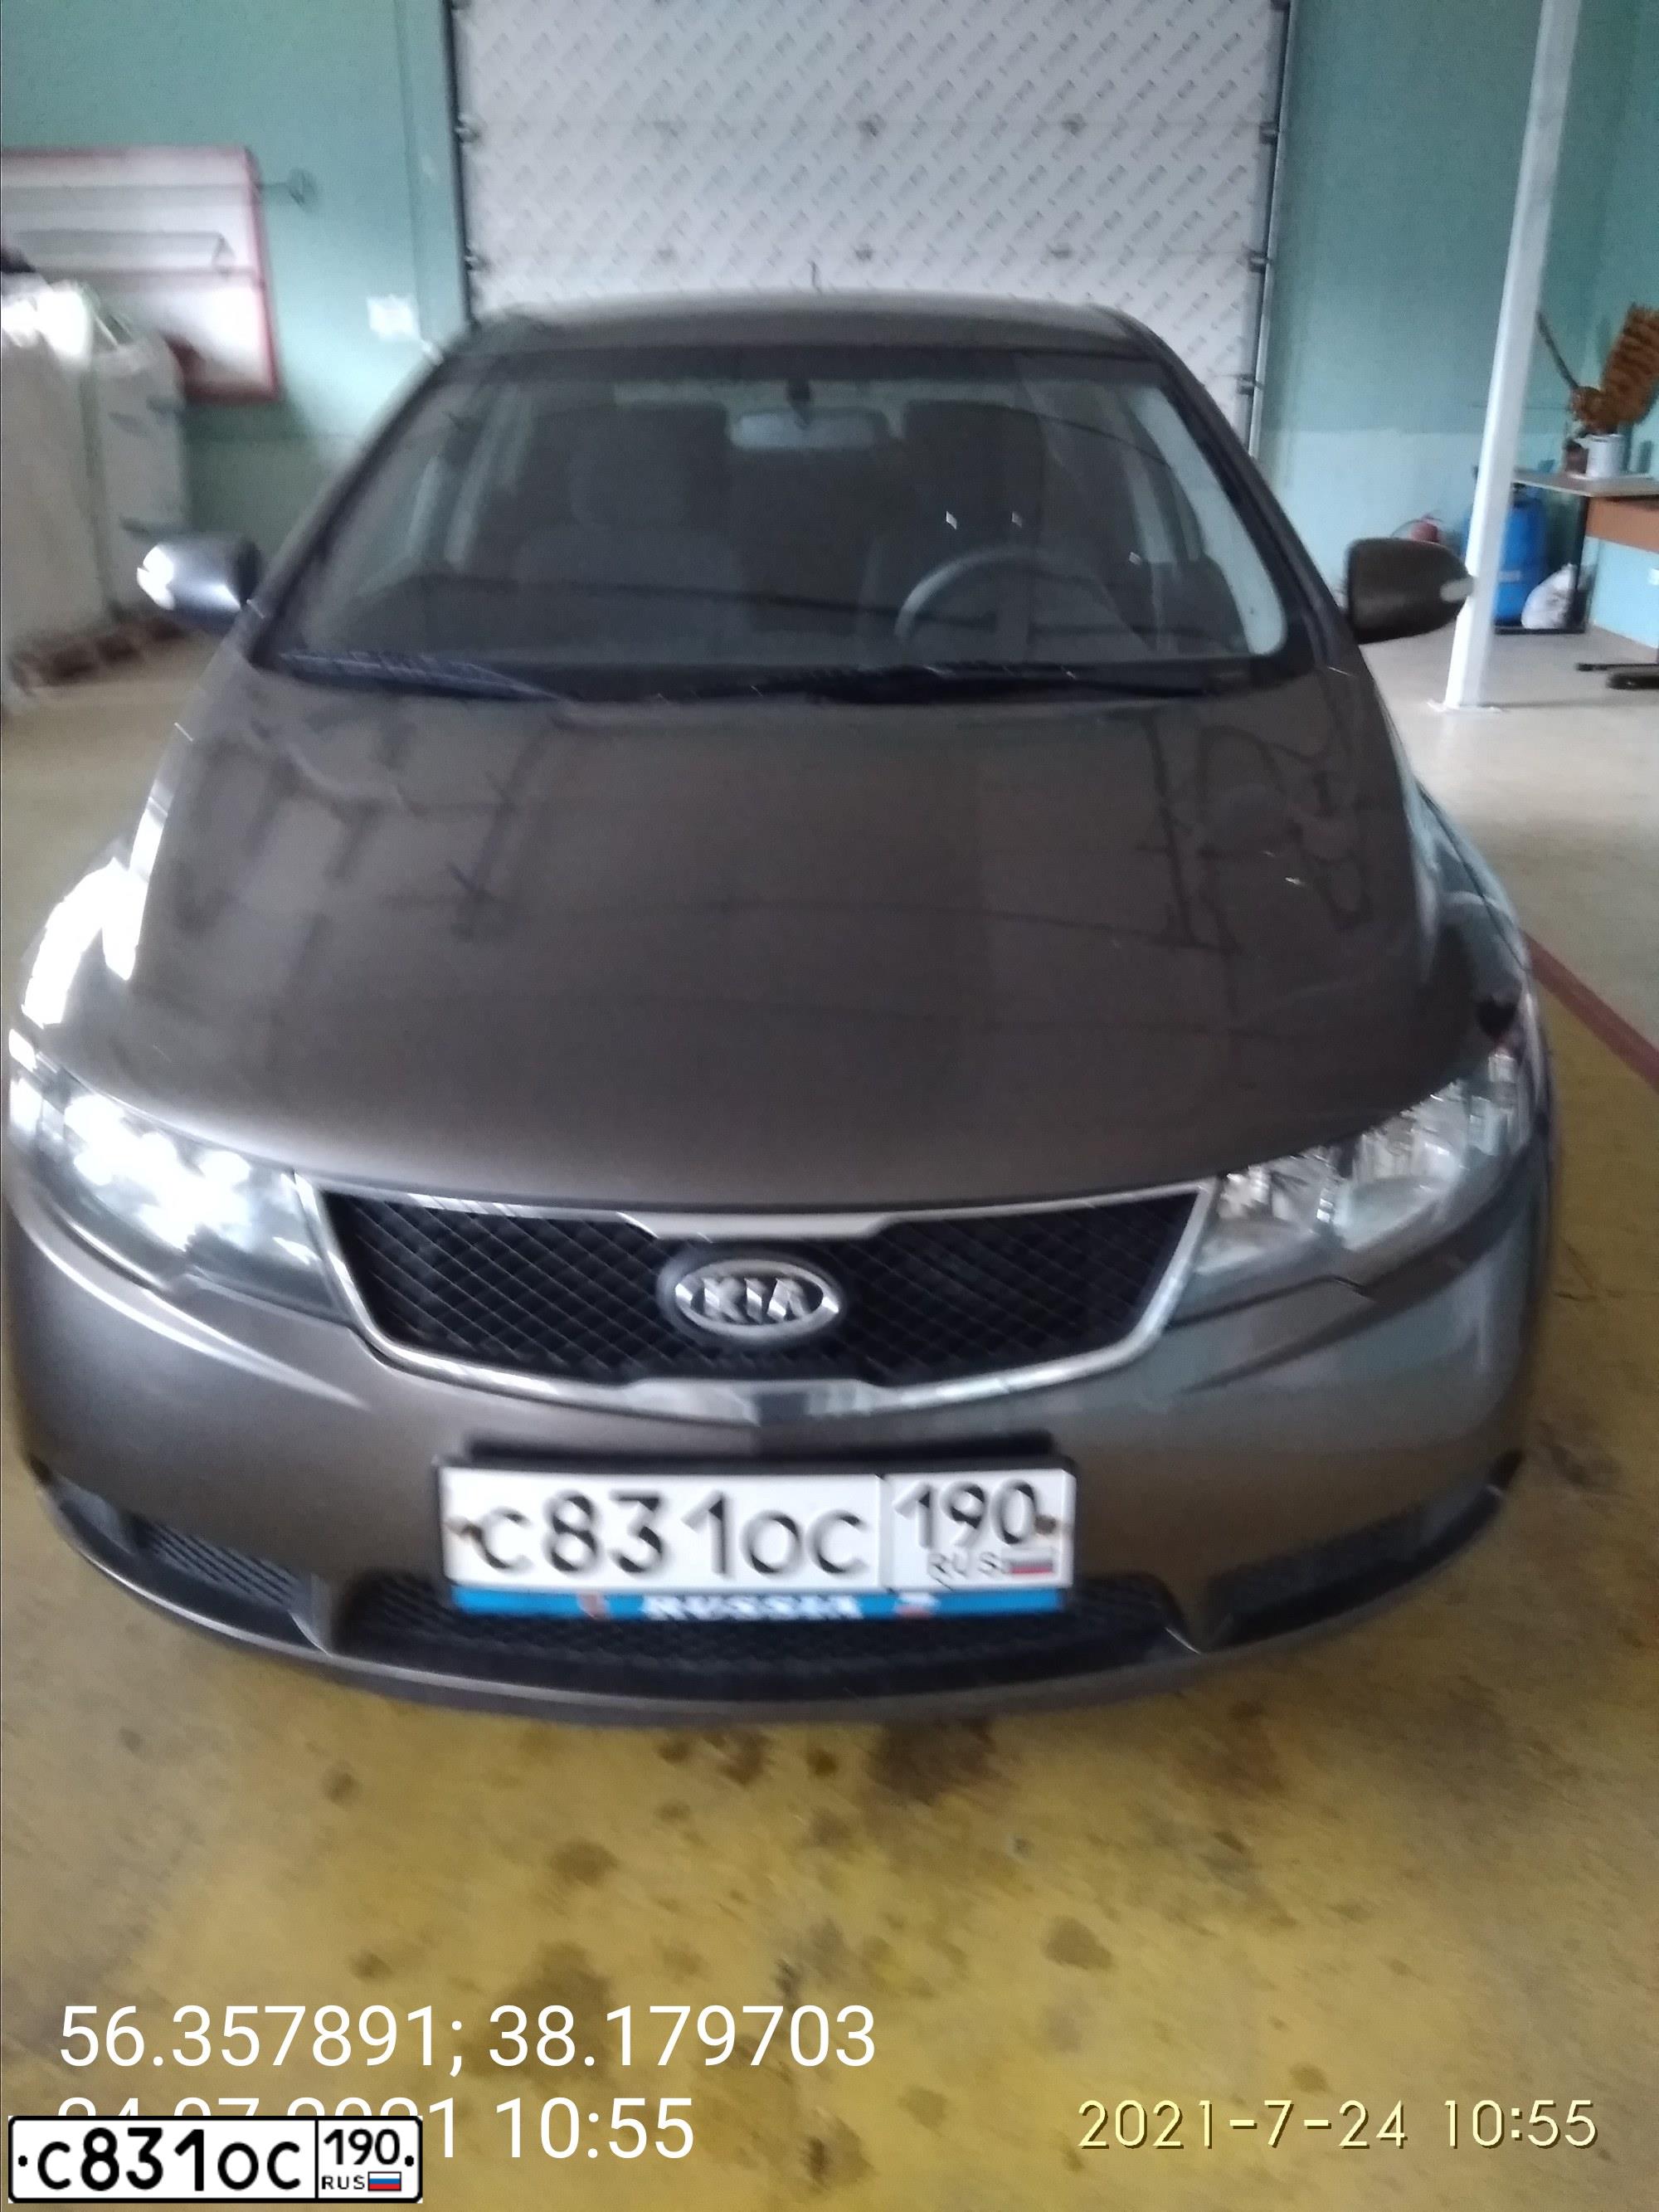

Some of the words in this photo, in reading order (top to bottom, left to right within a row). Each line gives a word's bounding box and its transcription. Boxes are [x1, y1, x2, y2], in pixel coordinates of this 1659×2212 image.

[701, 1276, 811, 1326] KIA
[892, 1479, 1038, 1547] 190
[927, 1551, 1005, 1581] RUS
[642, 1595, 864, 1620] RUSSIA
